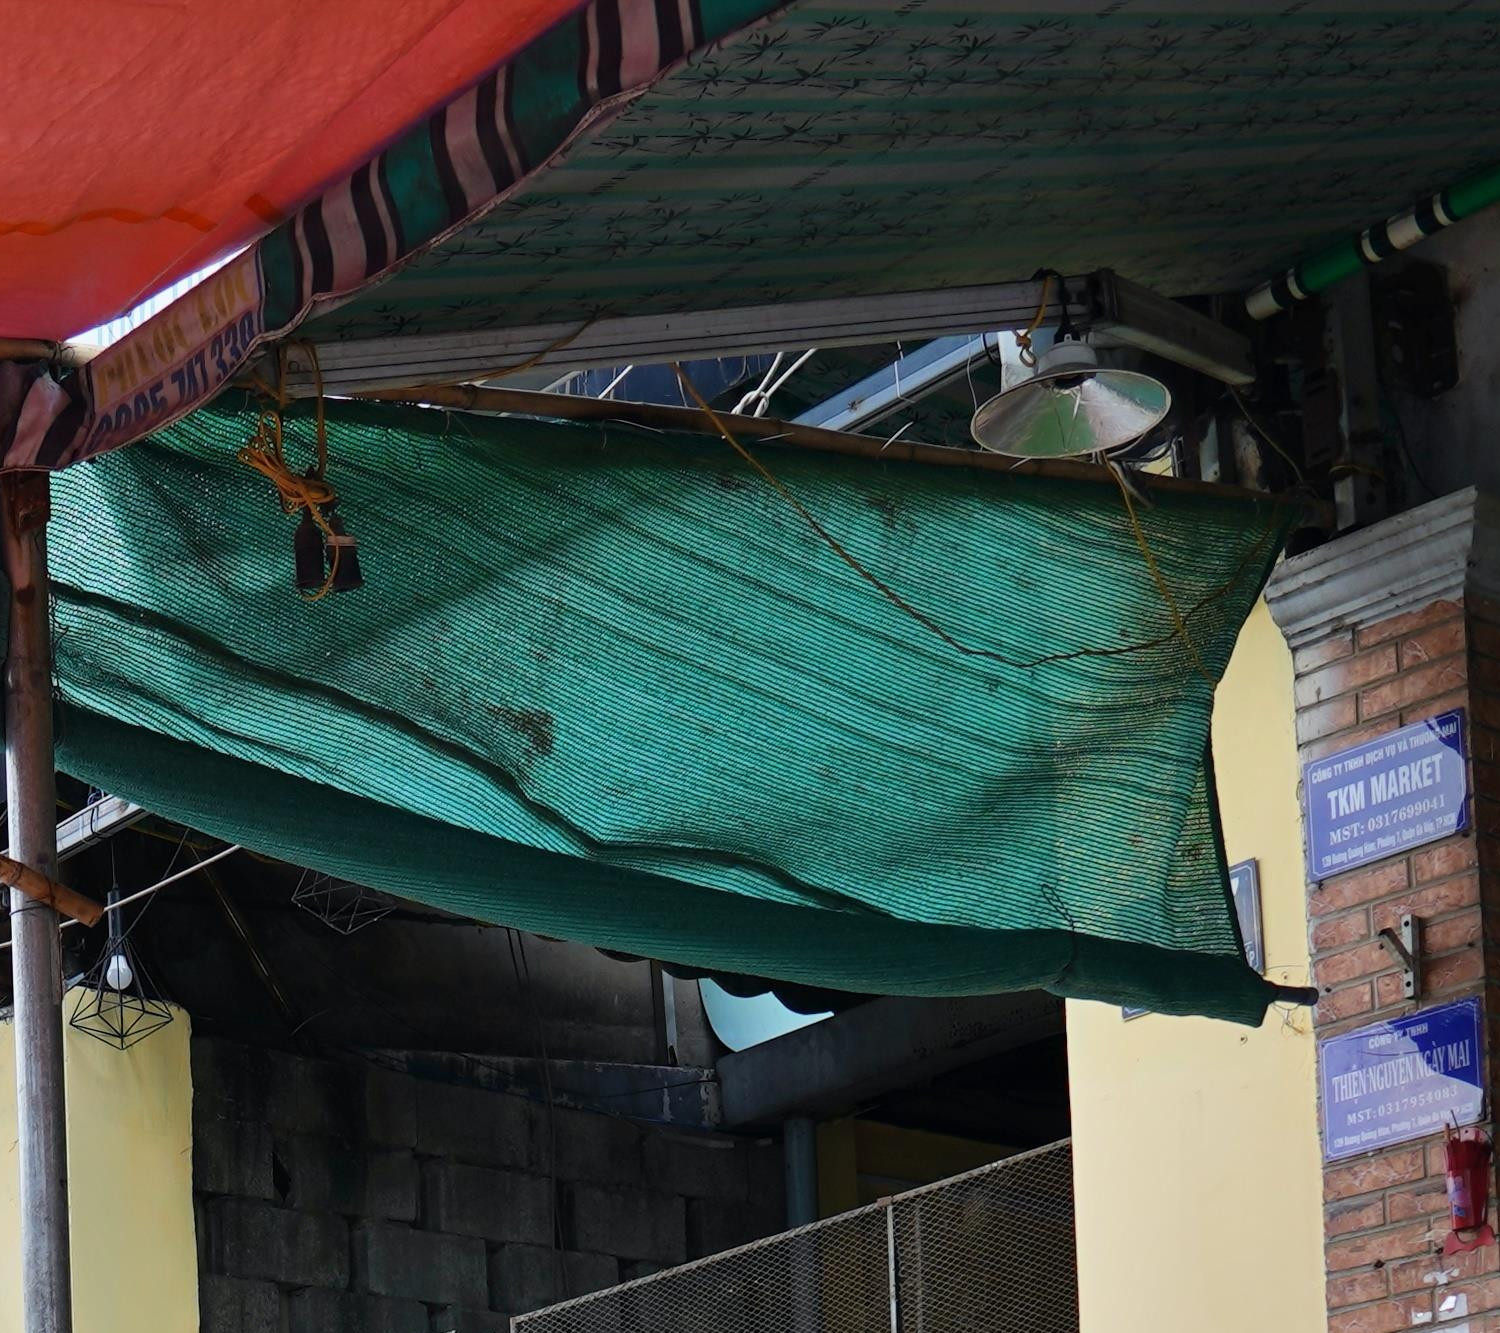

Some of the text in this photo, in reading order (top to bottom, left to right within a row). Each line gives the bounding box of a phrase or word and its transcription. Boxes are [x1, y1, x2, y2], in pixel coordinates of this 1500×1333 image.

[1327, 752, 1444, 820] TKM MARKET
[1329, 822, 1365, 846] MST:
[1448, 1039, 1470, 1071] MAI
